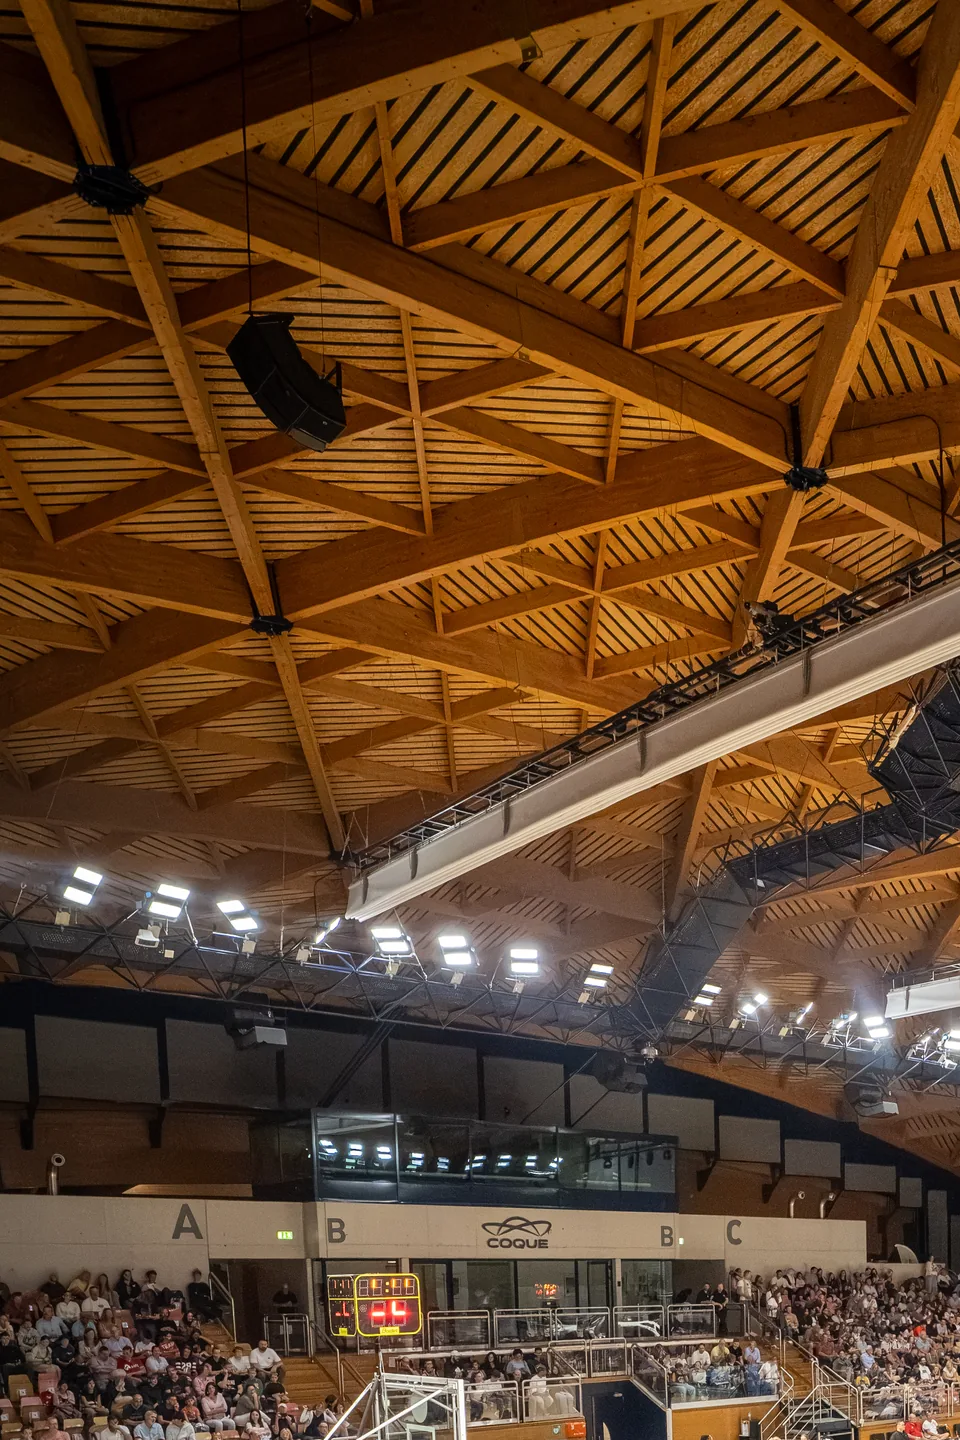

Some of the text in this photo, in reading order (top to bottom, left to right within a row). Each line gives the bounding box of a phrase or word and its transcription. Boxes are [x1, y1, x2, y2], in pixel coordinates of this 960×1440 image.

[172, 1203, 204, 1240] A
[327, 1218, 346, 1243] B
[726, 1219, 743, 1246] C
[487, 1237, 549, 1249] COQUE
[660, 1225, 674, 1247] B
